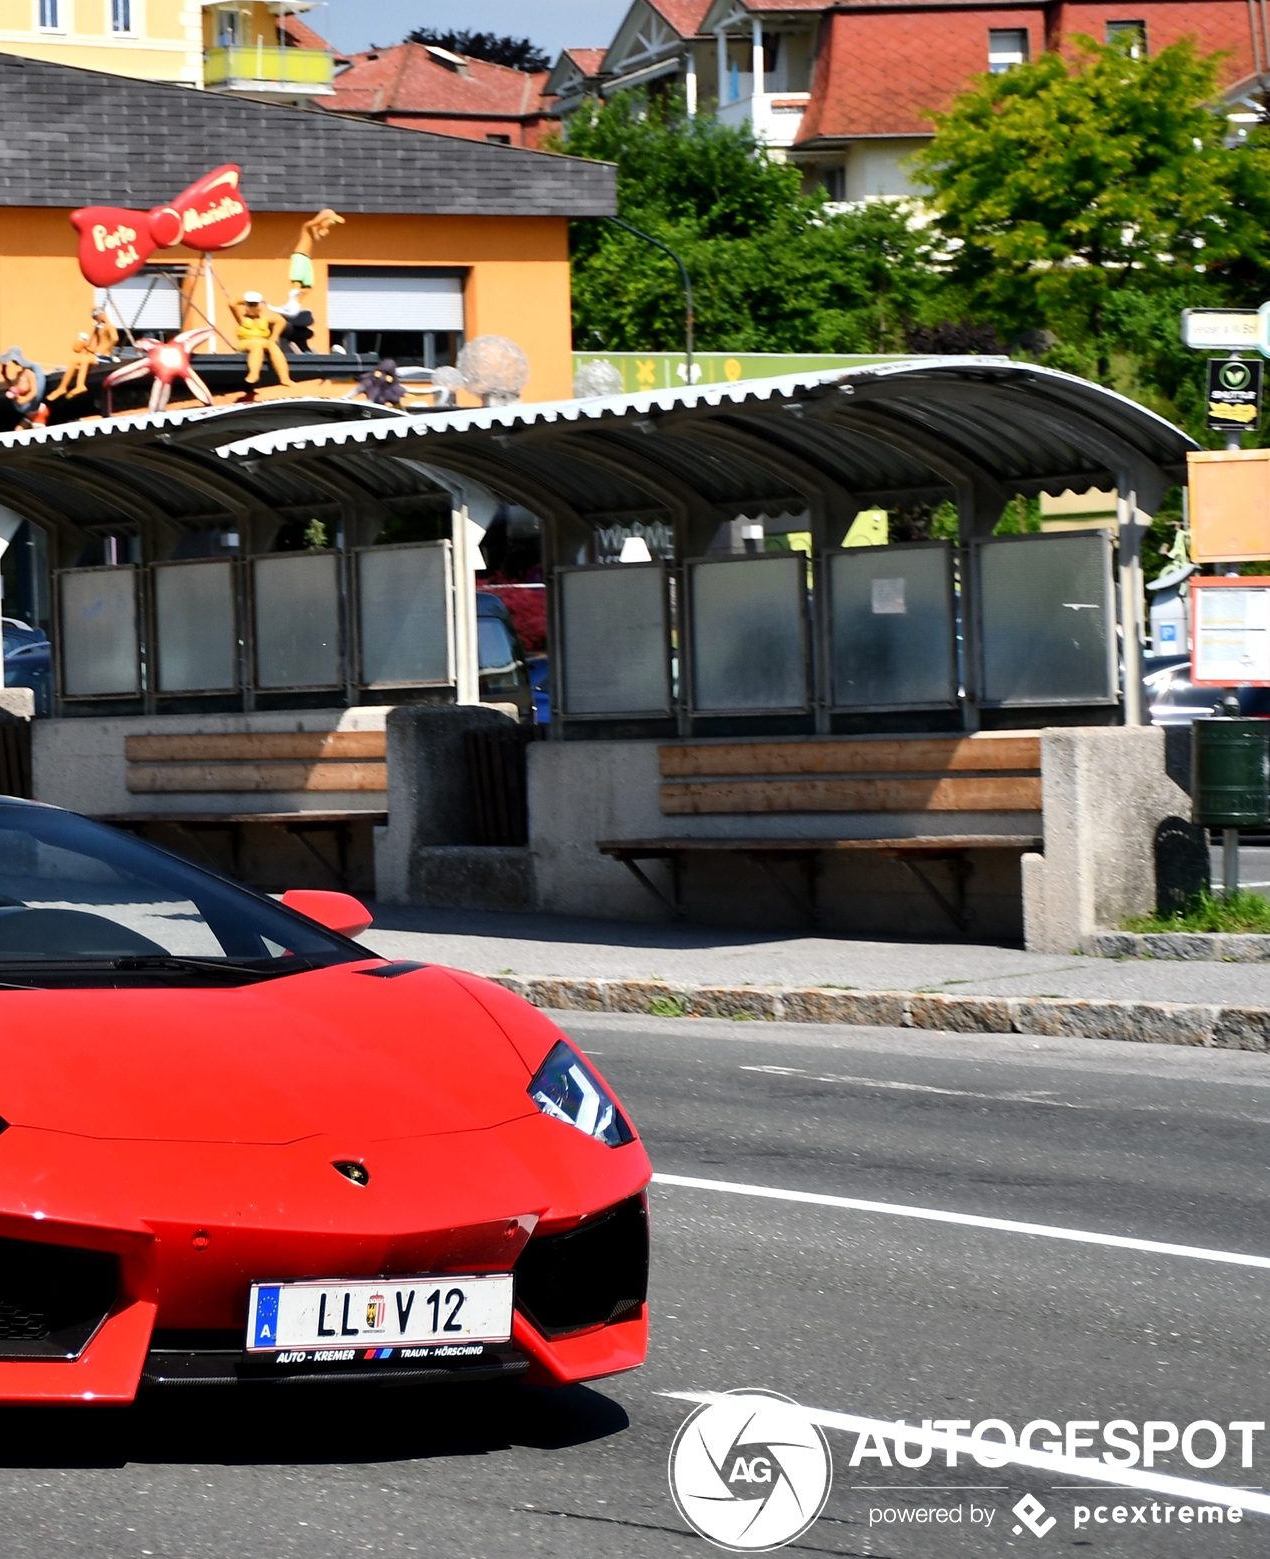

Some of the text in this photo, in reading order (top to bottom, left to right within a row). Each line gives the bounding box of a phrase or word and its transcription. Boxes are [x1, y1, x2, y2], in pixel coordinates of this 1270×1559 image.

[182, 196, 244, 232] Marietta
[91, 224, 137, 252] Porto
[115, 244, 140, 269] del
[317, 1288, 465, 1337] LL V 12
[260, 1324, 271, 1338] A
[276, 1351, 306, 1363] AUTO
[314, 1349, 356, 1362] KREMER
[400, 1348, 429, 1358] TRAUN
[434, 1345, 484, 1356] HÖRSCHING
